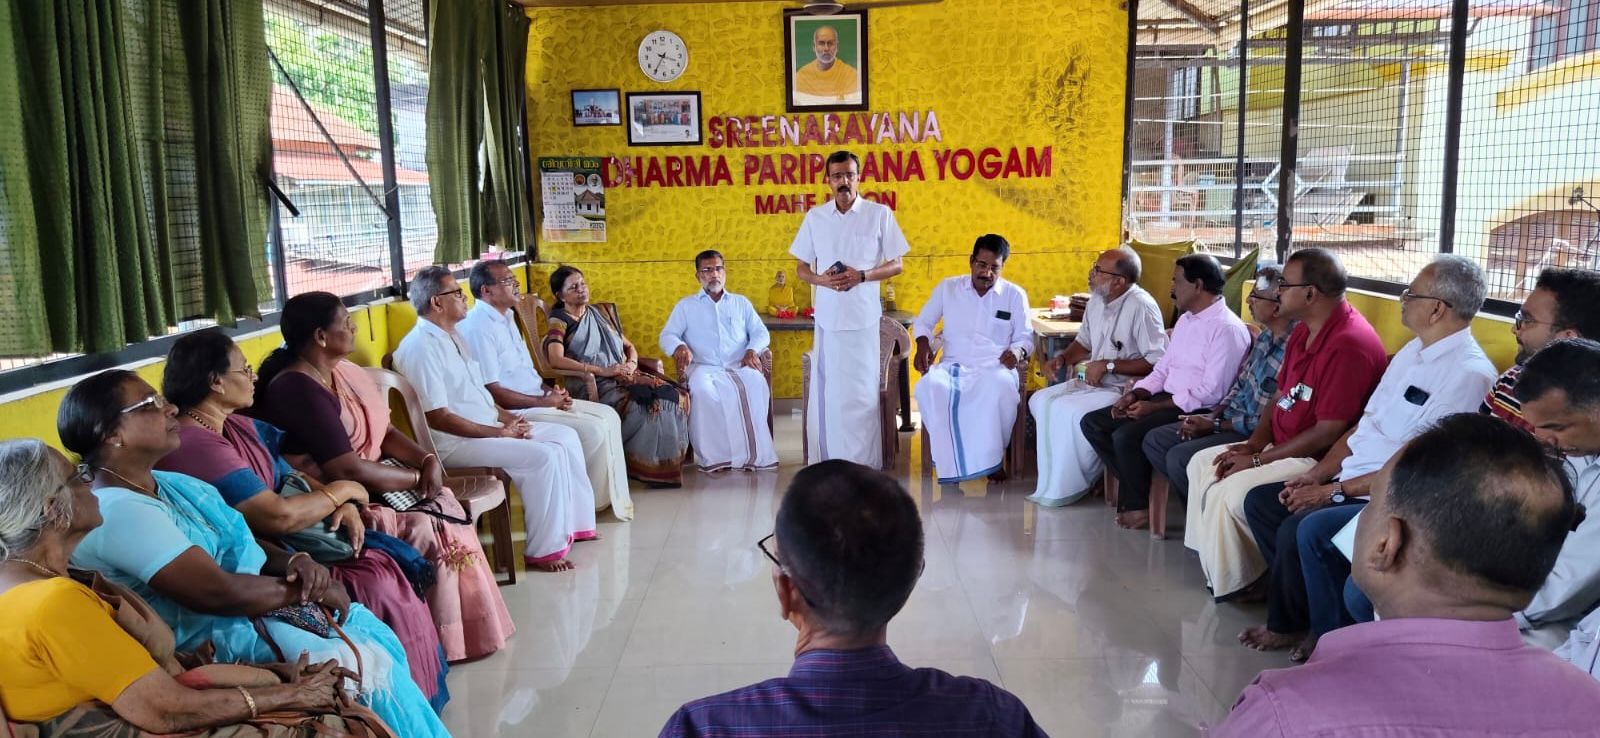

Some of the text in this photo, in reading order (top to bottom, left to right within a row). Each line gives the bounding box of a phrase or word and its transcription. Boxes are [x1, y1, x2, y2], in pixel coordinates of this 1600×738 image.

[708, 110, 942, 149] SREENARAYANA
[603, 145, 1052, 188] DHARMA PARIPANA YOGAM
